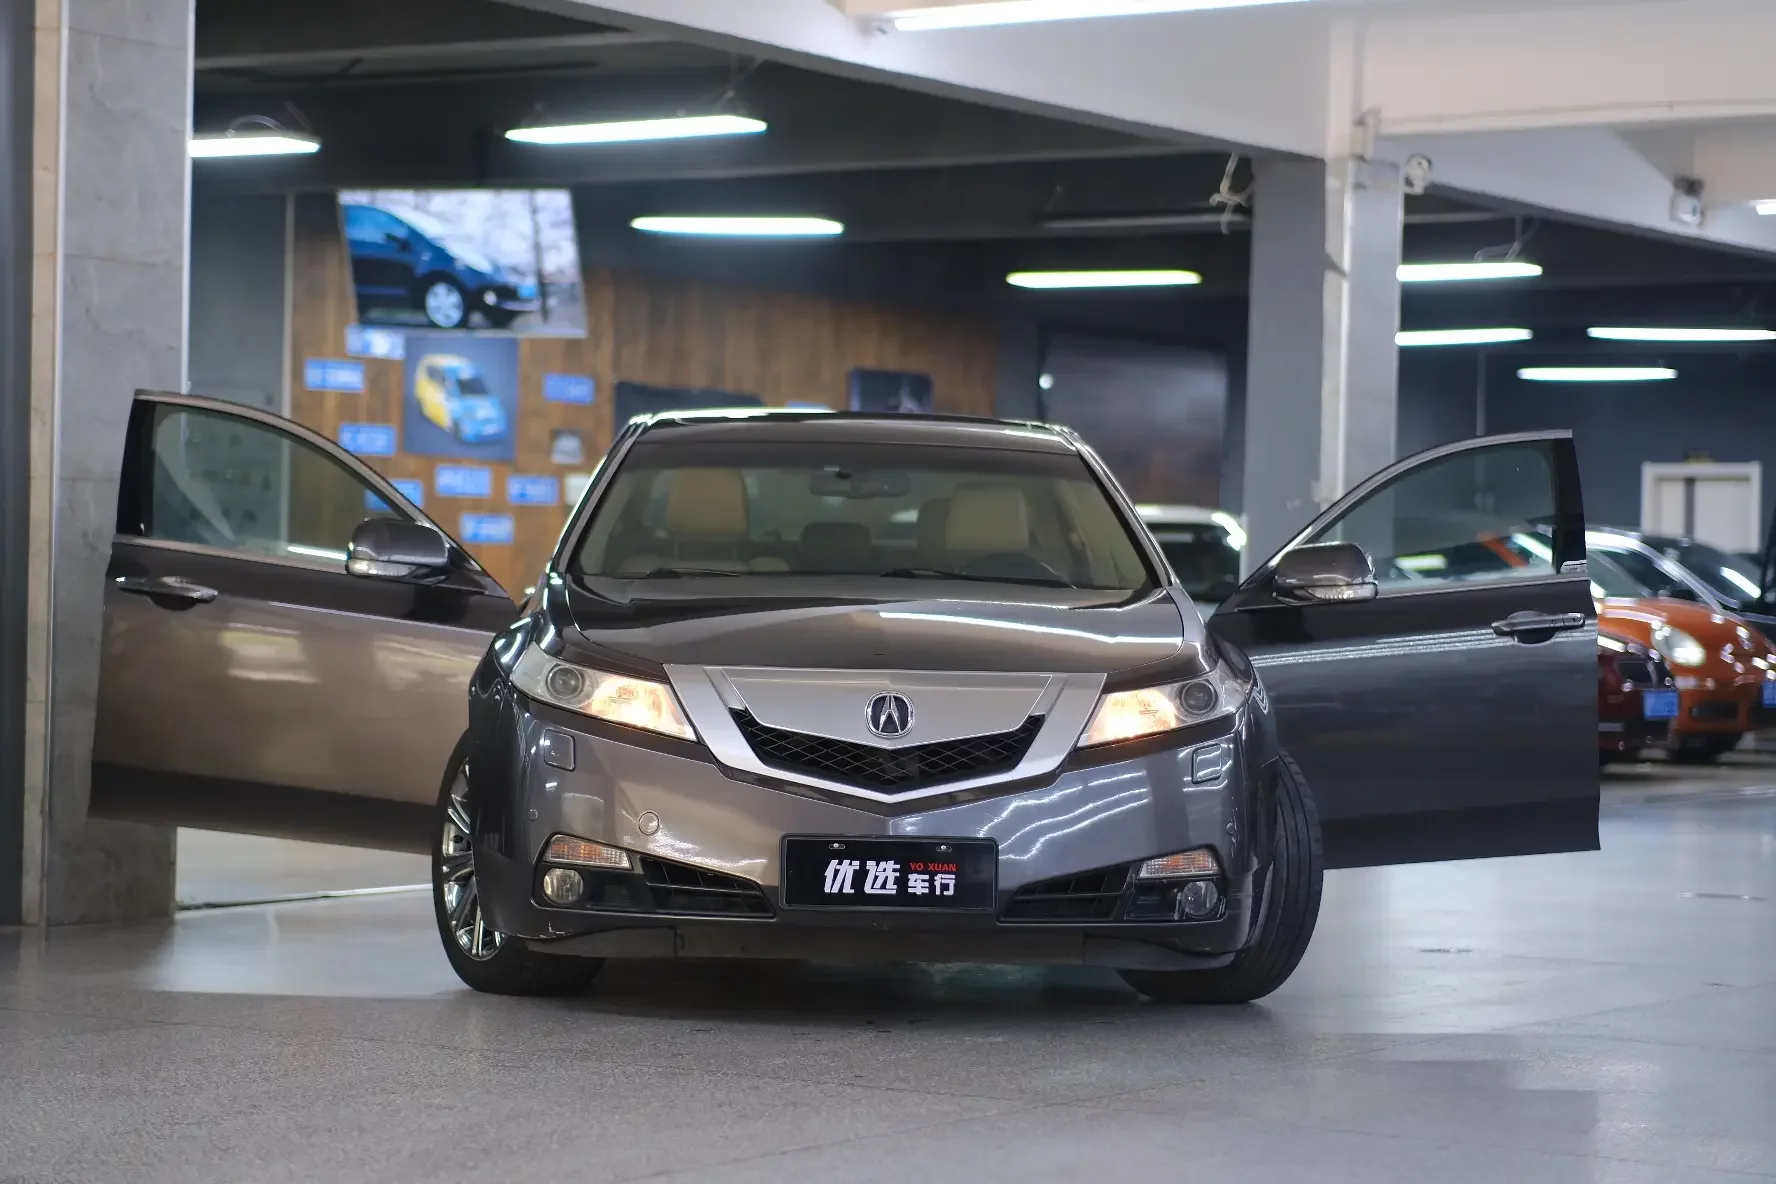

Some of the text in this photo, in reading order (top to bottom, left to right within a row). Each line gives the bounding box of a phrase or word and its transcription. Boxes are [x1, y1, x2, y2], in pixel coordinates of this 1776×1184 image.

[824, 859, 900, 895] 优选
[909, 862, 957, 872] YO XUAN
[907, 873, 956, 895] 车行
